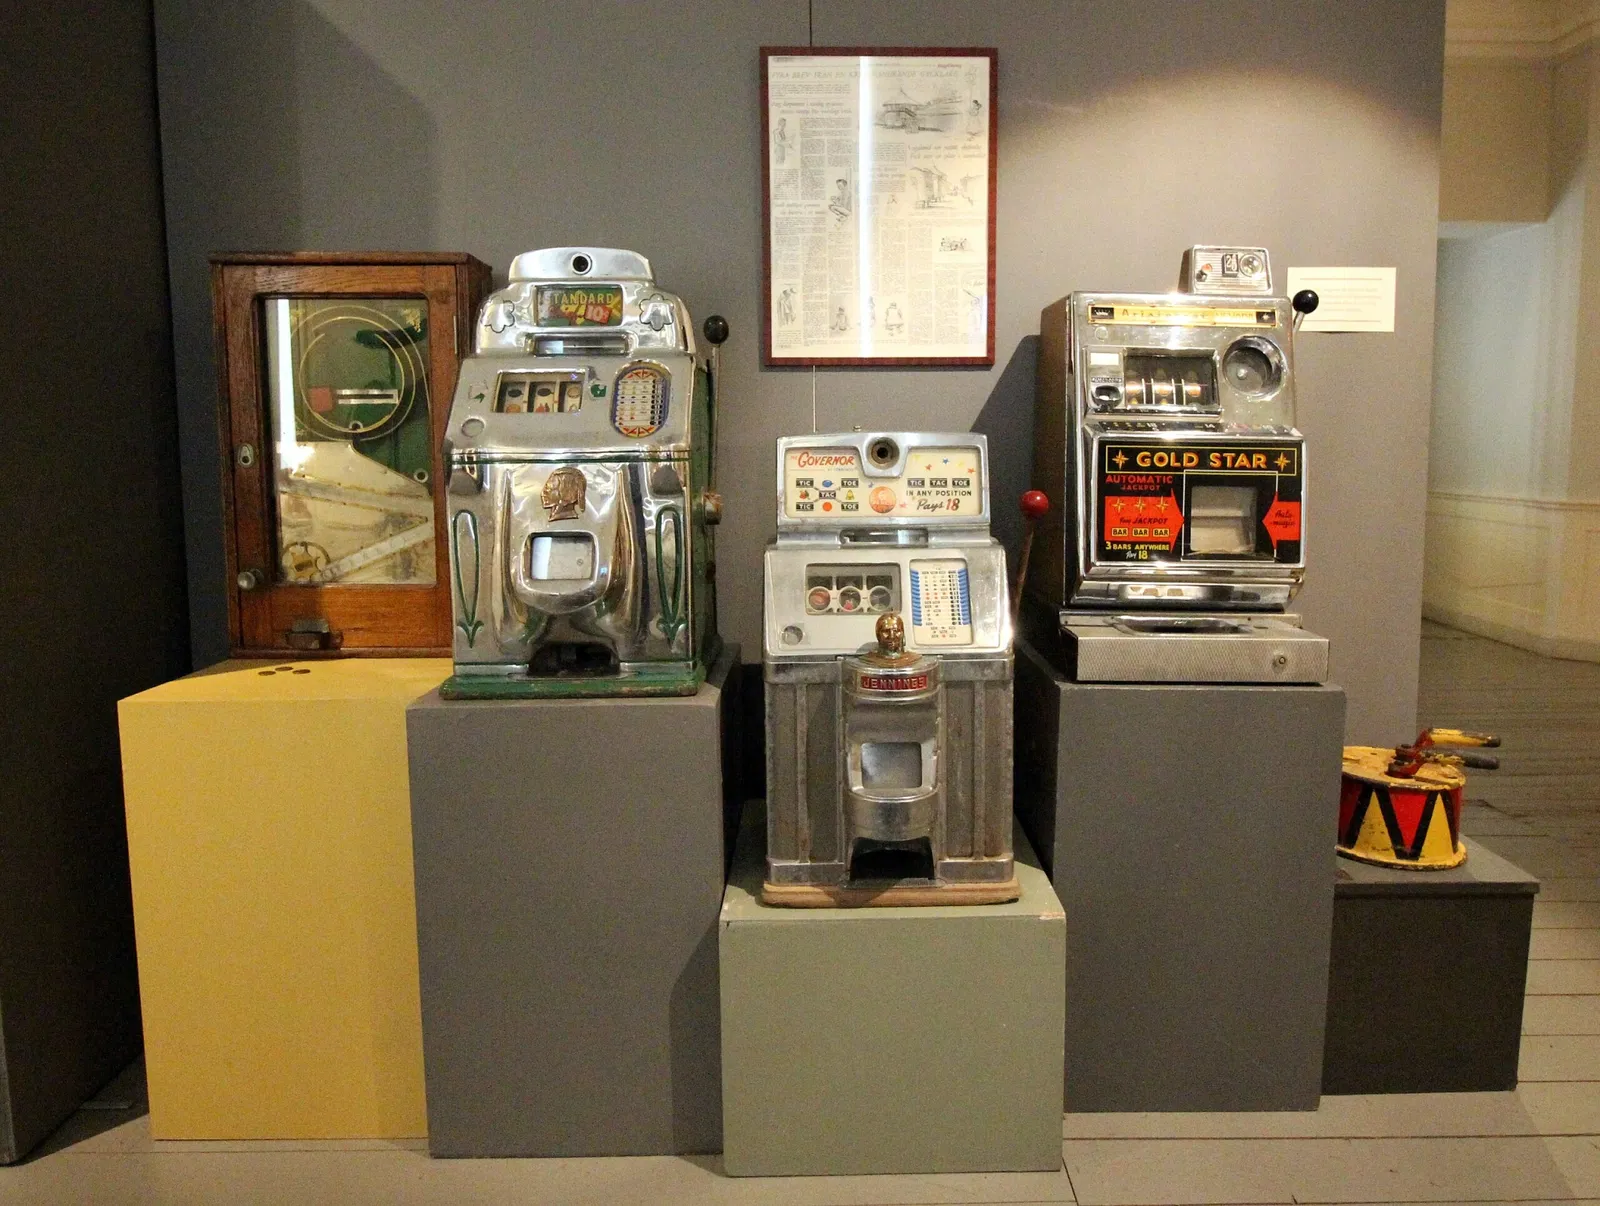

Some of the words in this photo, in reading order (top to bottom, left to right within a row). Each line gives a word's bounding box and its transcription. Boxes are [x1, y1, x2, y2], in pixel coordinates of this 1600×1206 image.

[543, 292, 614, 305] STANDARD
[1136, 451, 1199, 468] GOLD
[1209, 452, 1268, 469] STAR
[1105, 474, 1173, 485] AUTOMATIC
[916, 499, 944, 513] Pays
[945, 498, 961, 511] 18
[1132, 517, 1168, 525] JACKPOT
[1105, 541, 1111, 550] 3
[1138, 550, 1148, 560] 18
[863, 676, 926, 689] JENNINGS
